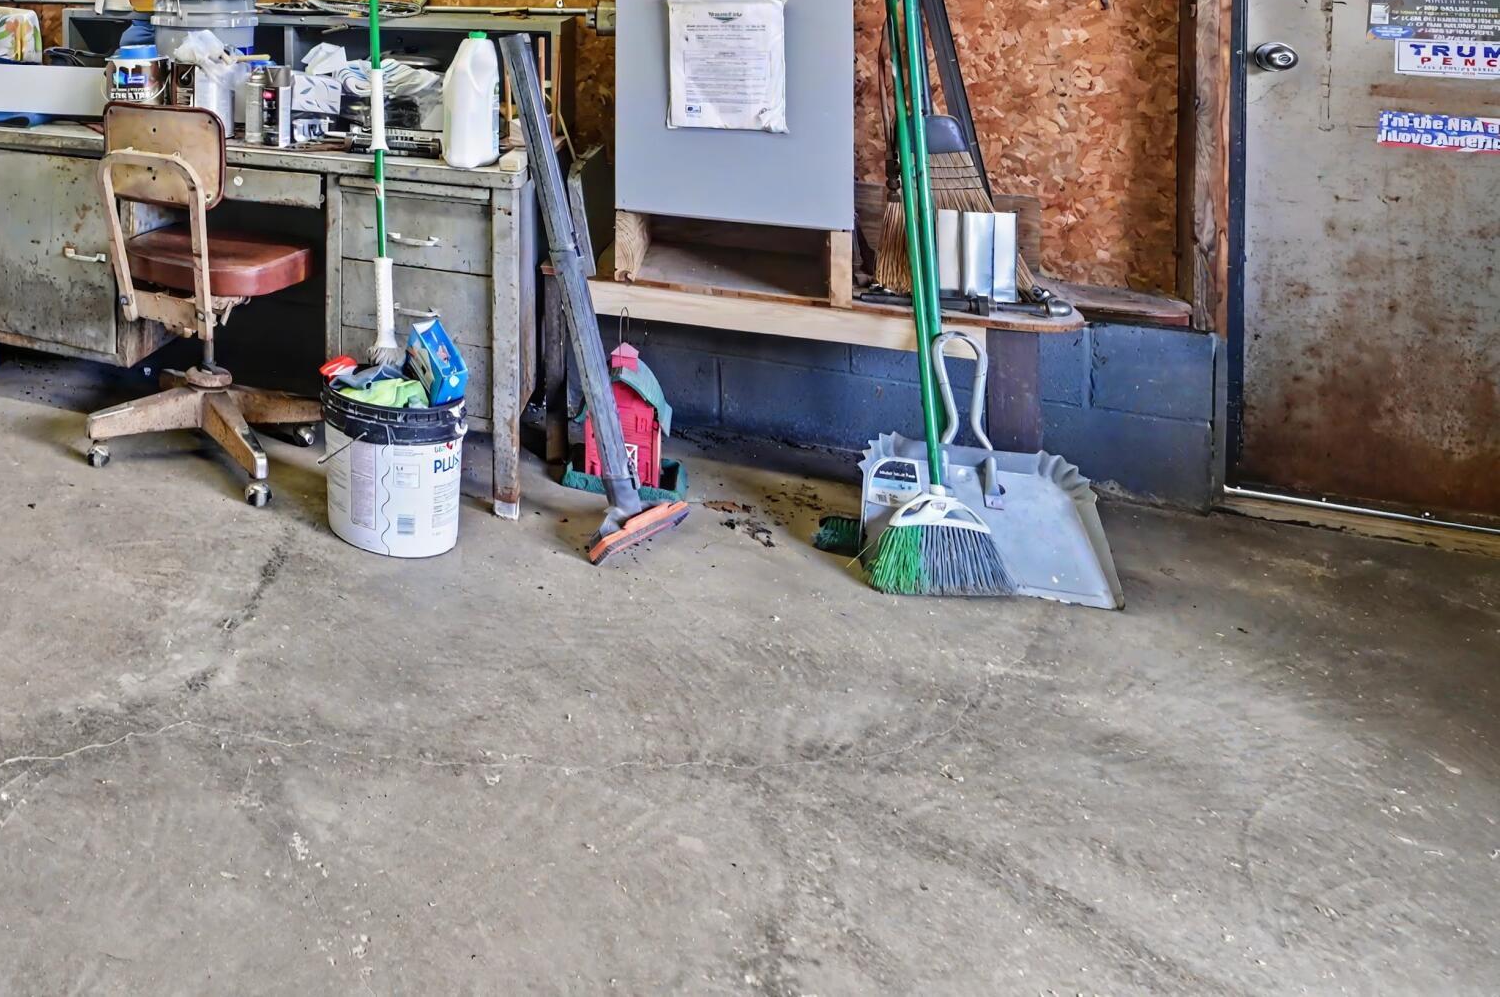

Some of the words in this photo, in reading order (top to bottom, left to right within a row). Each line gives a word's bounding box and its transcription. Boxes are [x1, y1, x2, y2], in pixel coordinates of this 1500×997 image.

[1409, 43, 1500, 58] TRUM
[1420, 56, 1498, 68] PENC
[1412, 115, 1444, 130] the
[1447, 117, 1485, 133] NRA
